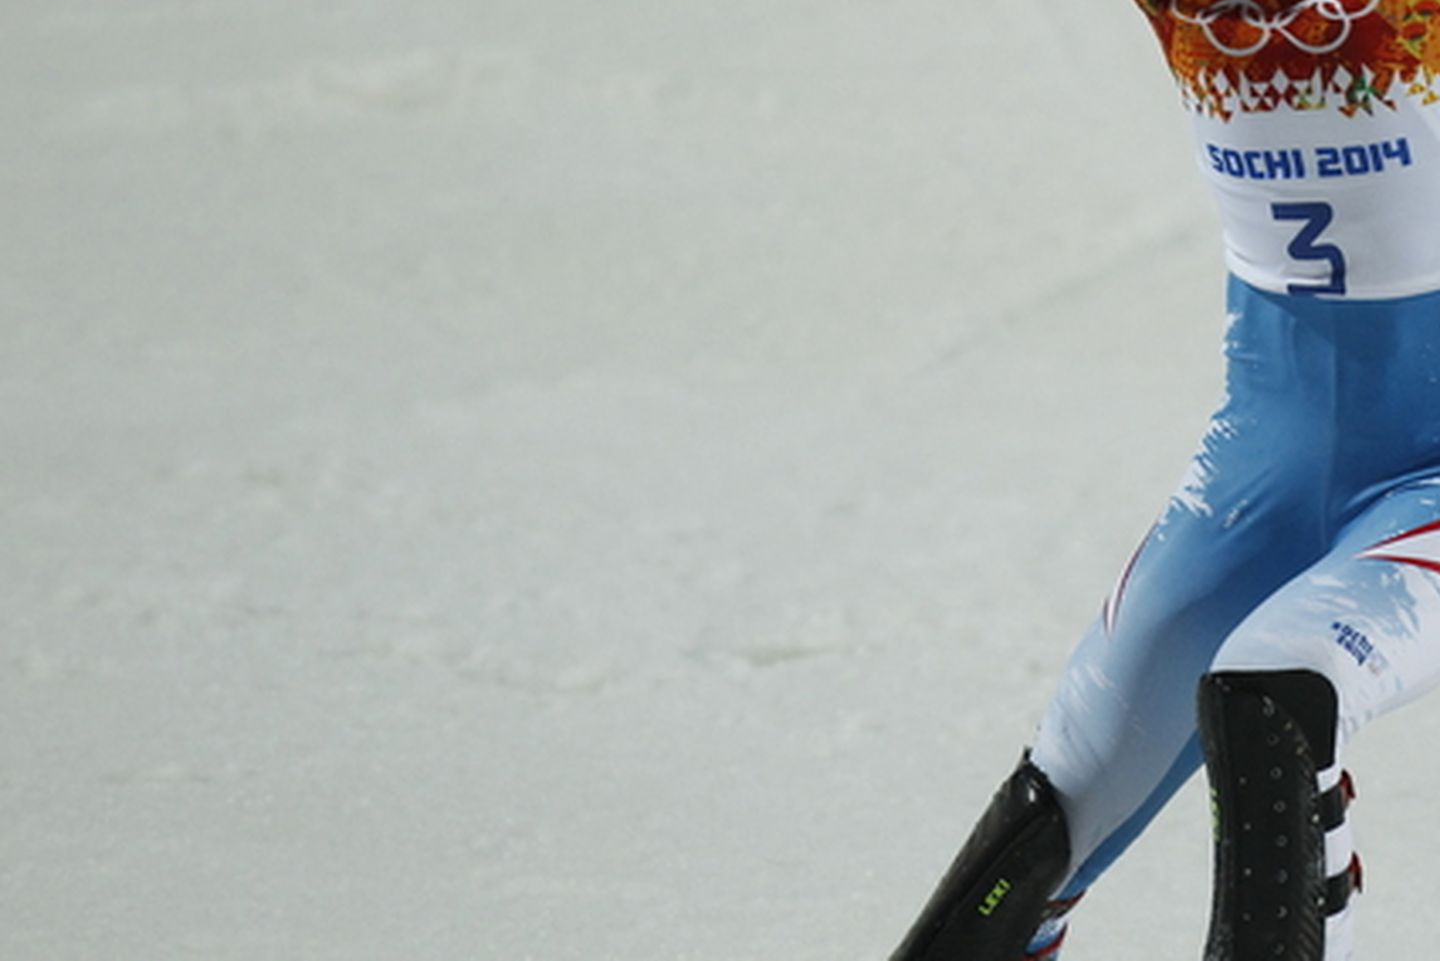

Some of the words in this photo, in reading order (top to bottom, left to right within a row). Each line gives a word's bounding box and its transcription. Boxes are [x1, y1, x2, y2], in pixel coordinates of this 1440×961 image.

[1206, 142, 1306, 180] SOCHI
[1314, 136, 1413, 178] 2014
[1270, 201, 1347, 297] 3
